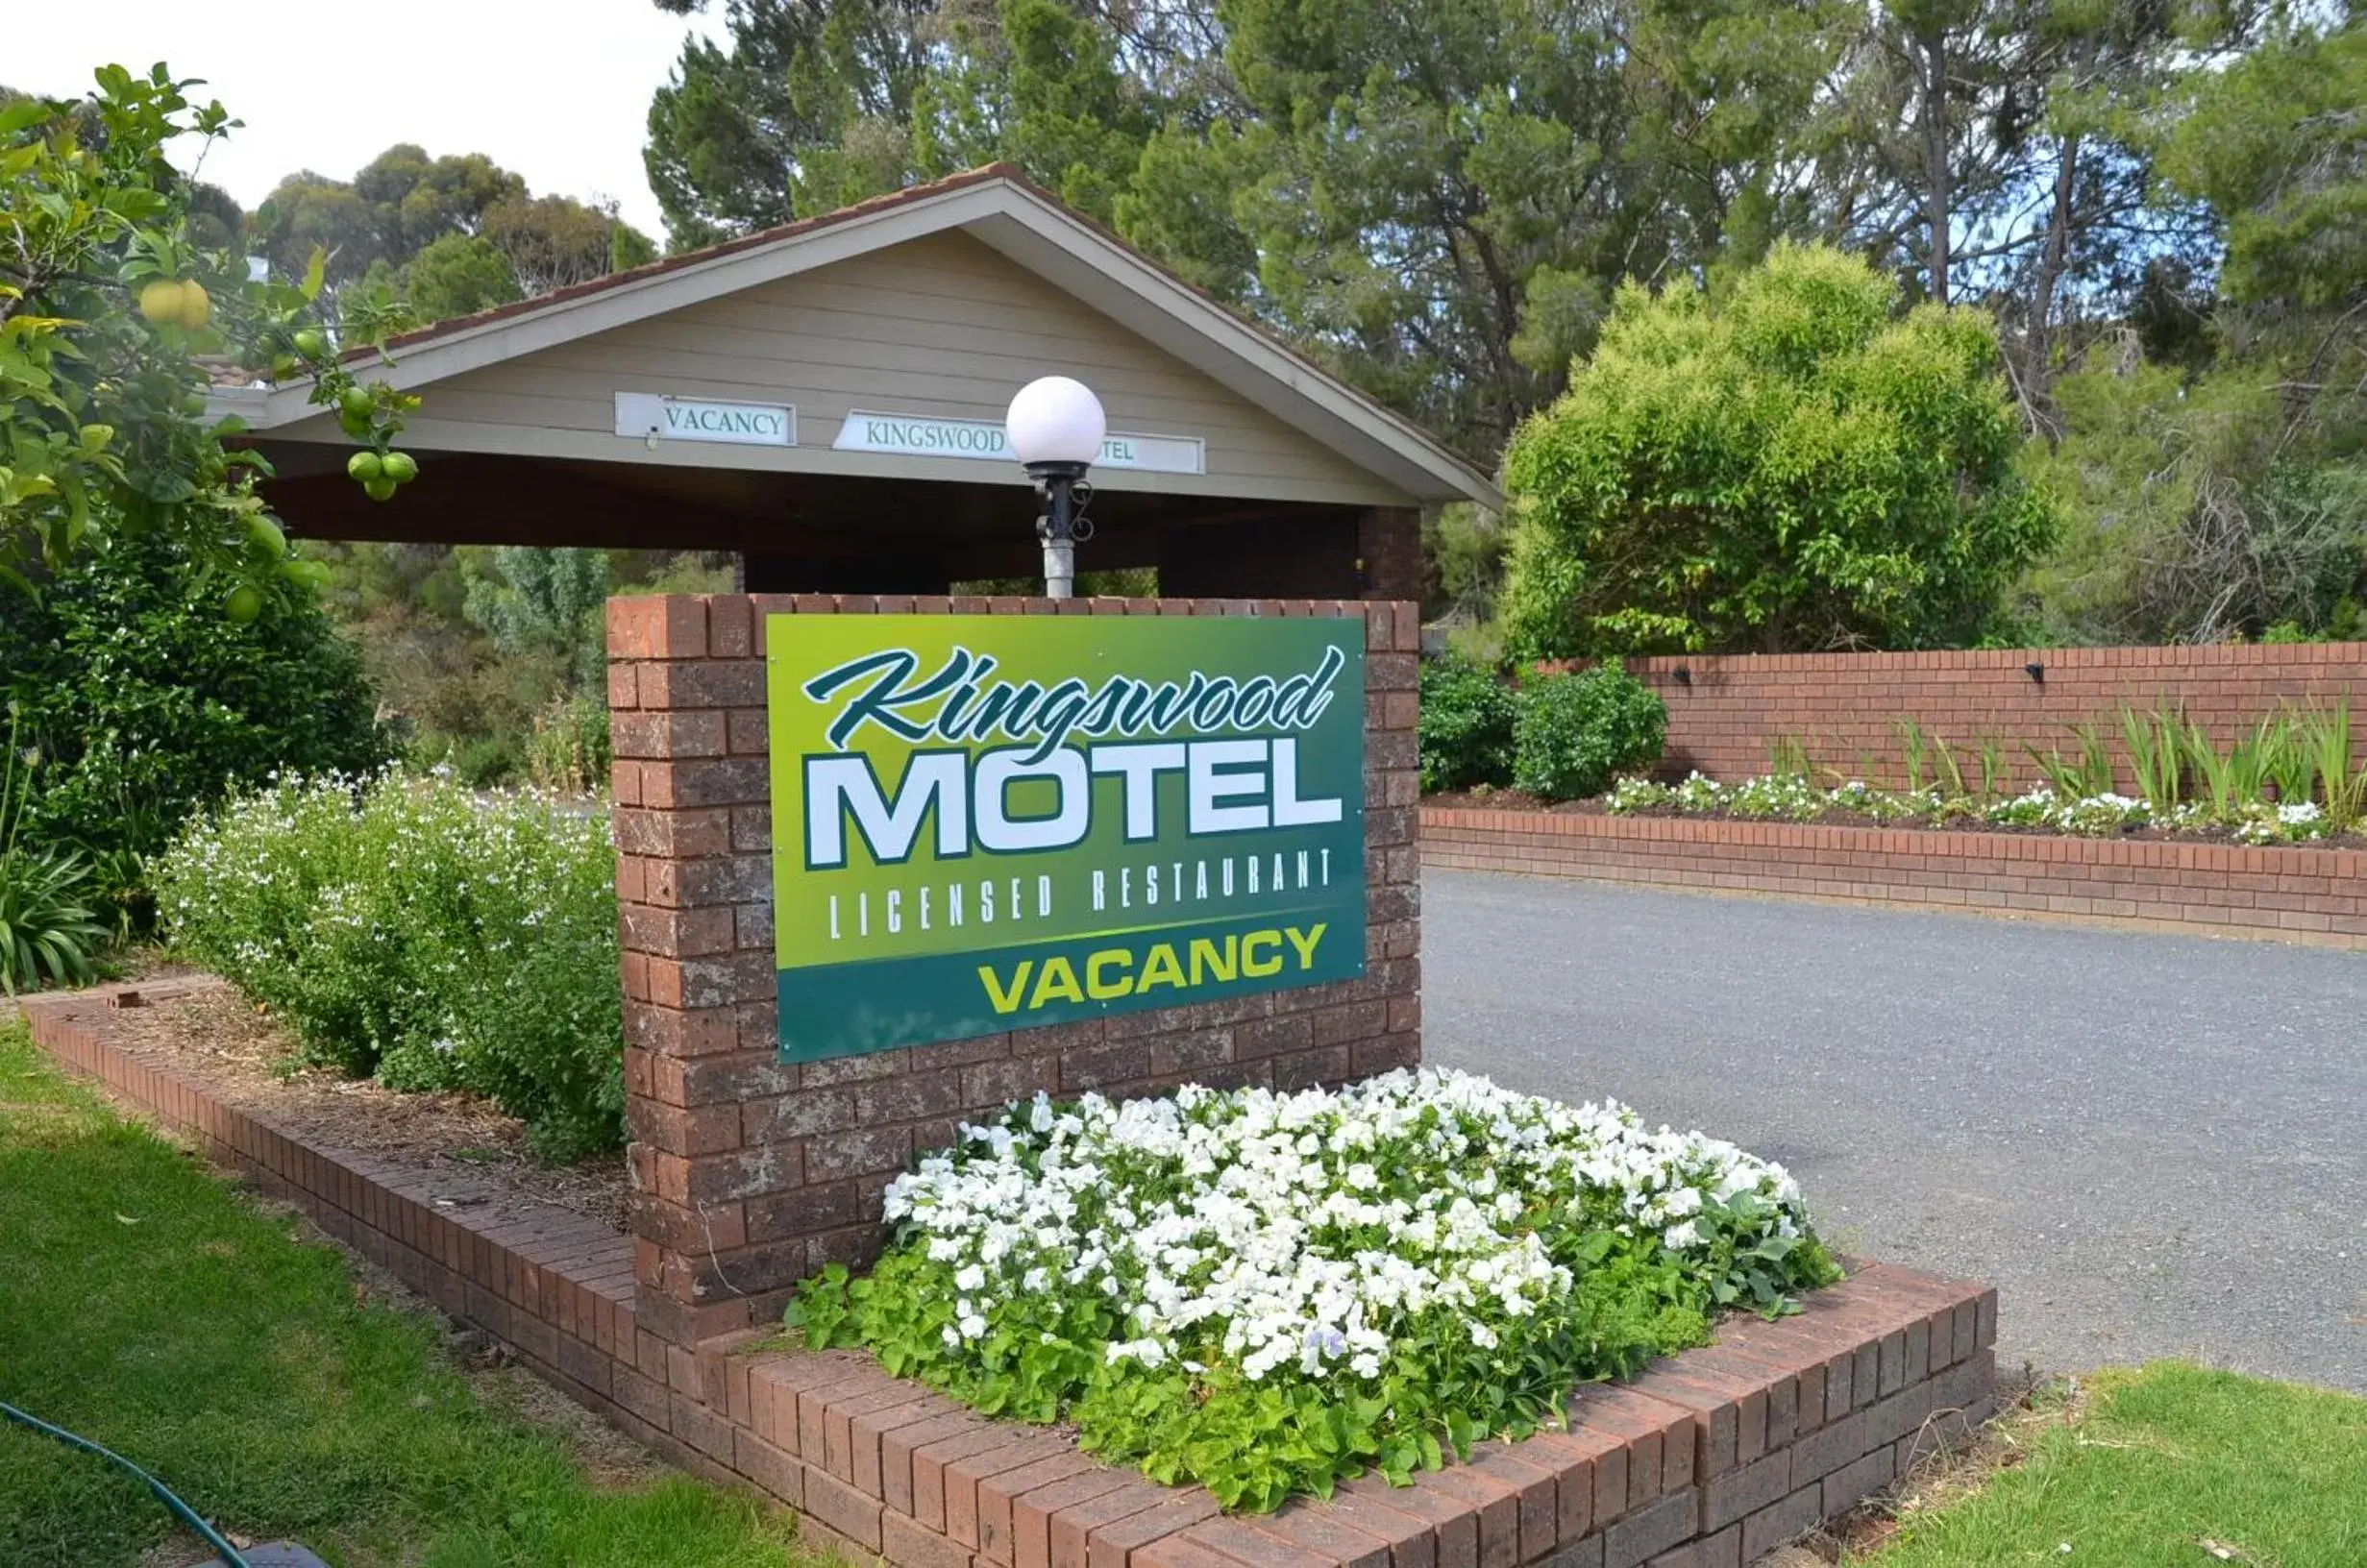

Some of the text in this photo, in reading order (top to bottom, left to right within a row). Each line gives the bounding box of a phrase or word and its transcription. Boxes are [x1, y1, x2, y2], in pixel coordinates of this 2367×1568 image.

[665, 405, 782, 435] VACANCY
[867, 421, 1134, 460] KINGSWOOD TEL
[802, 646, 1344, 765] Kingswood
[803, 736, 1343, 870] MOTEL
[829, 848, 1330, 939] LICENSED RESTAURANT
[978, 923, 1327, 1015] VACANCY
